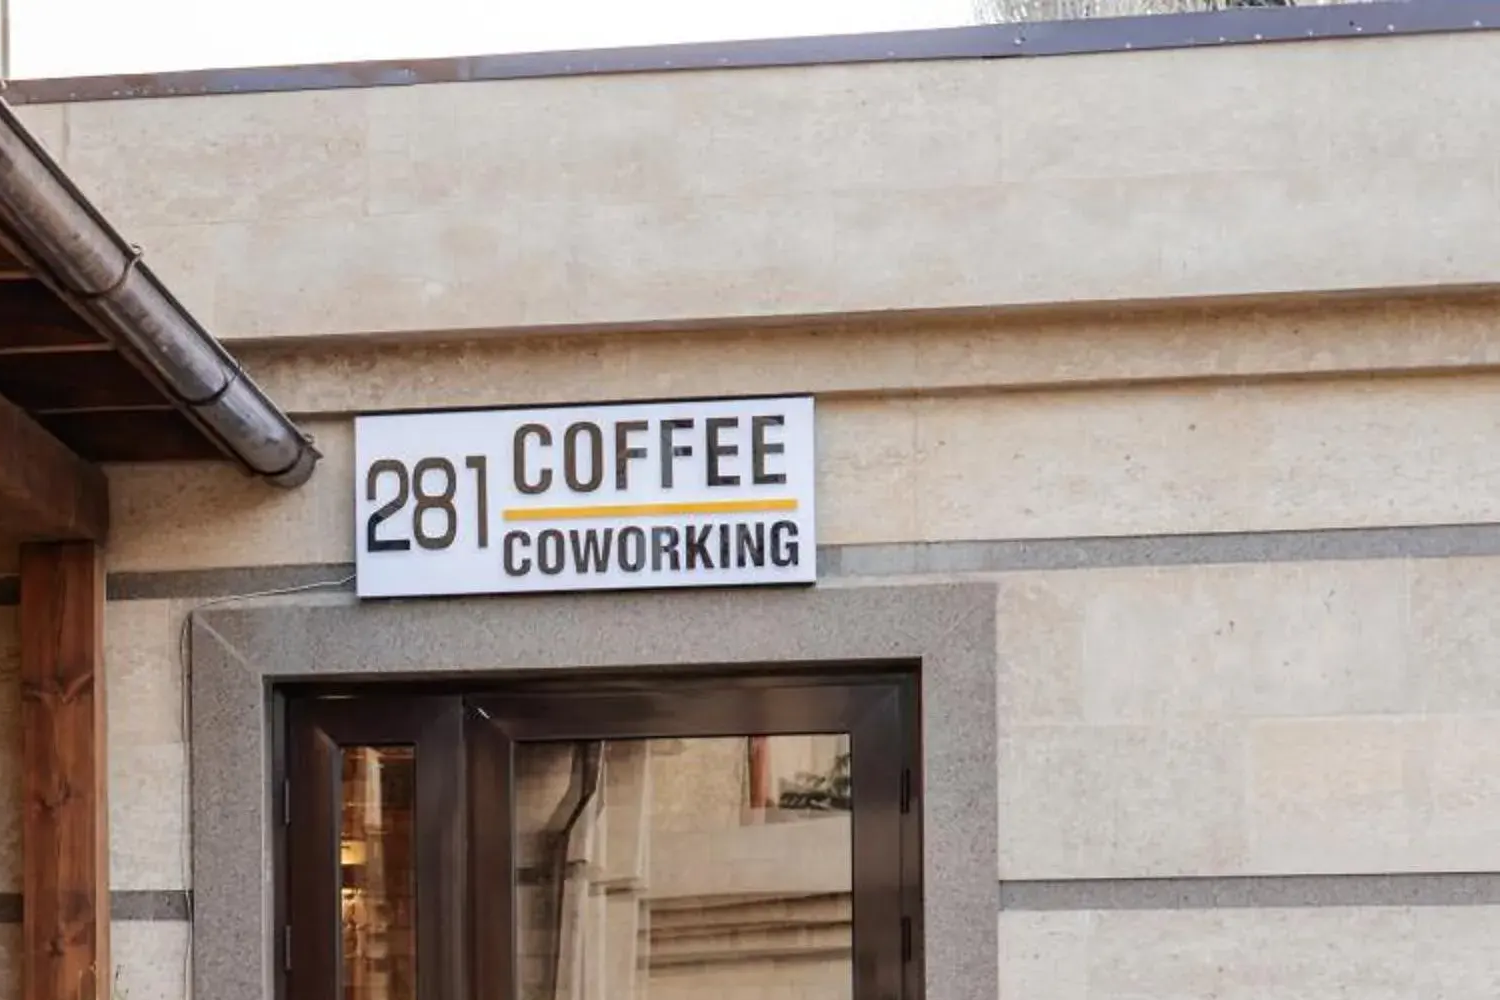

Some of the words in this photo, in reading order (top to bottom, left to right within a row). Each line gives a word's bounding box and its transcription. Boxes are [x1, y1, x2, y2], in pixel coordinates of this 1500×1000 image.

[513, 415, 787, 494] COFFEE
[367, 455, 488, 552] 281
[503, 520, 799, 577] COWORKING
